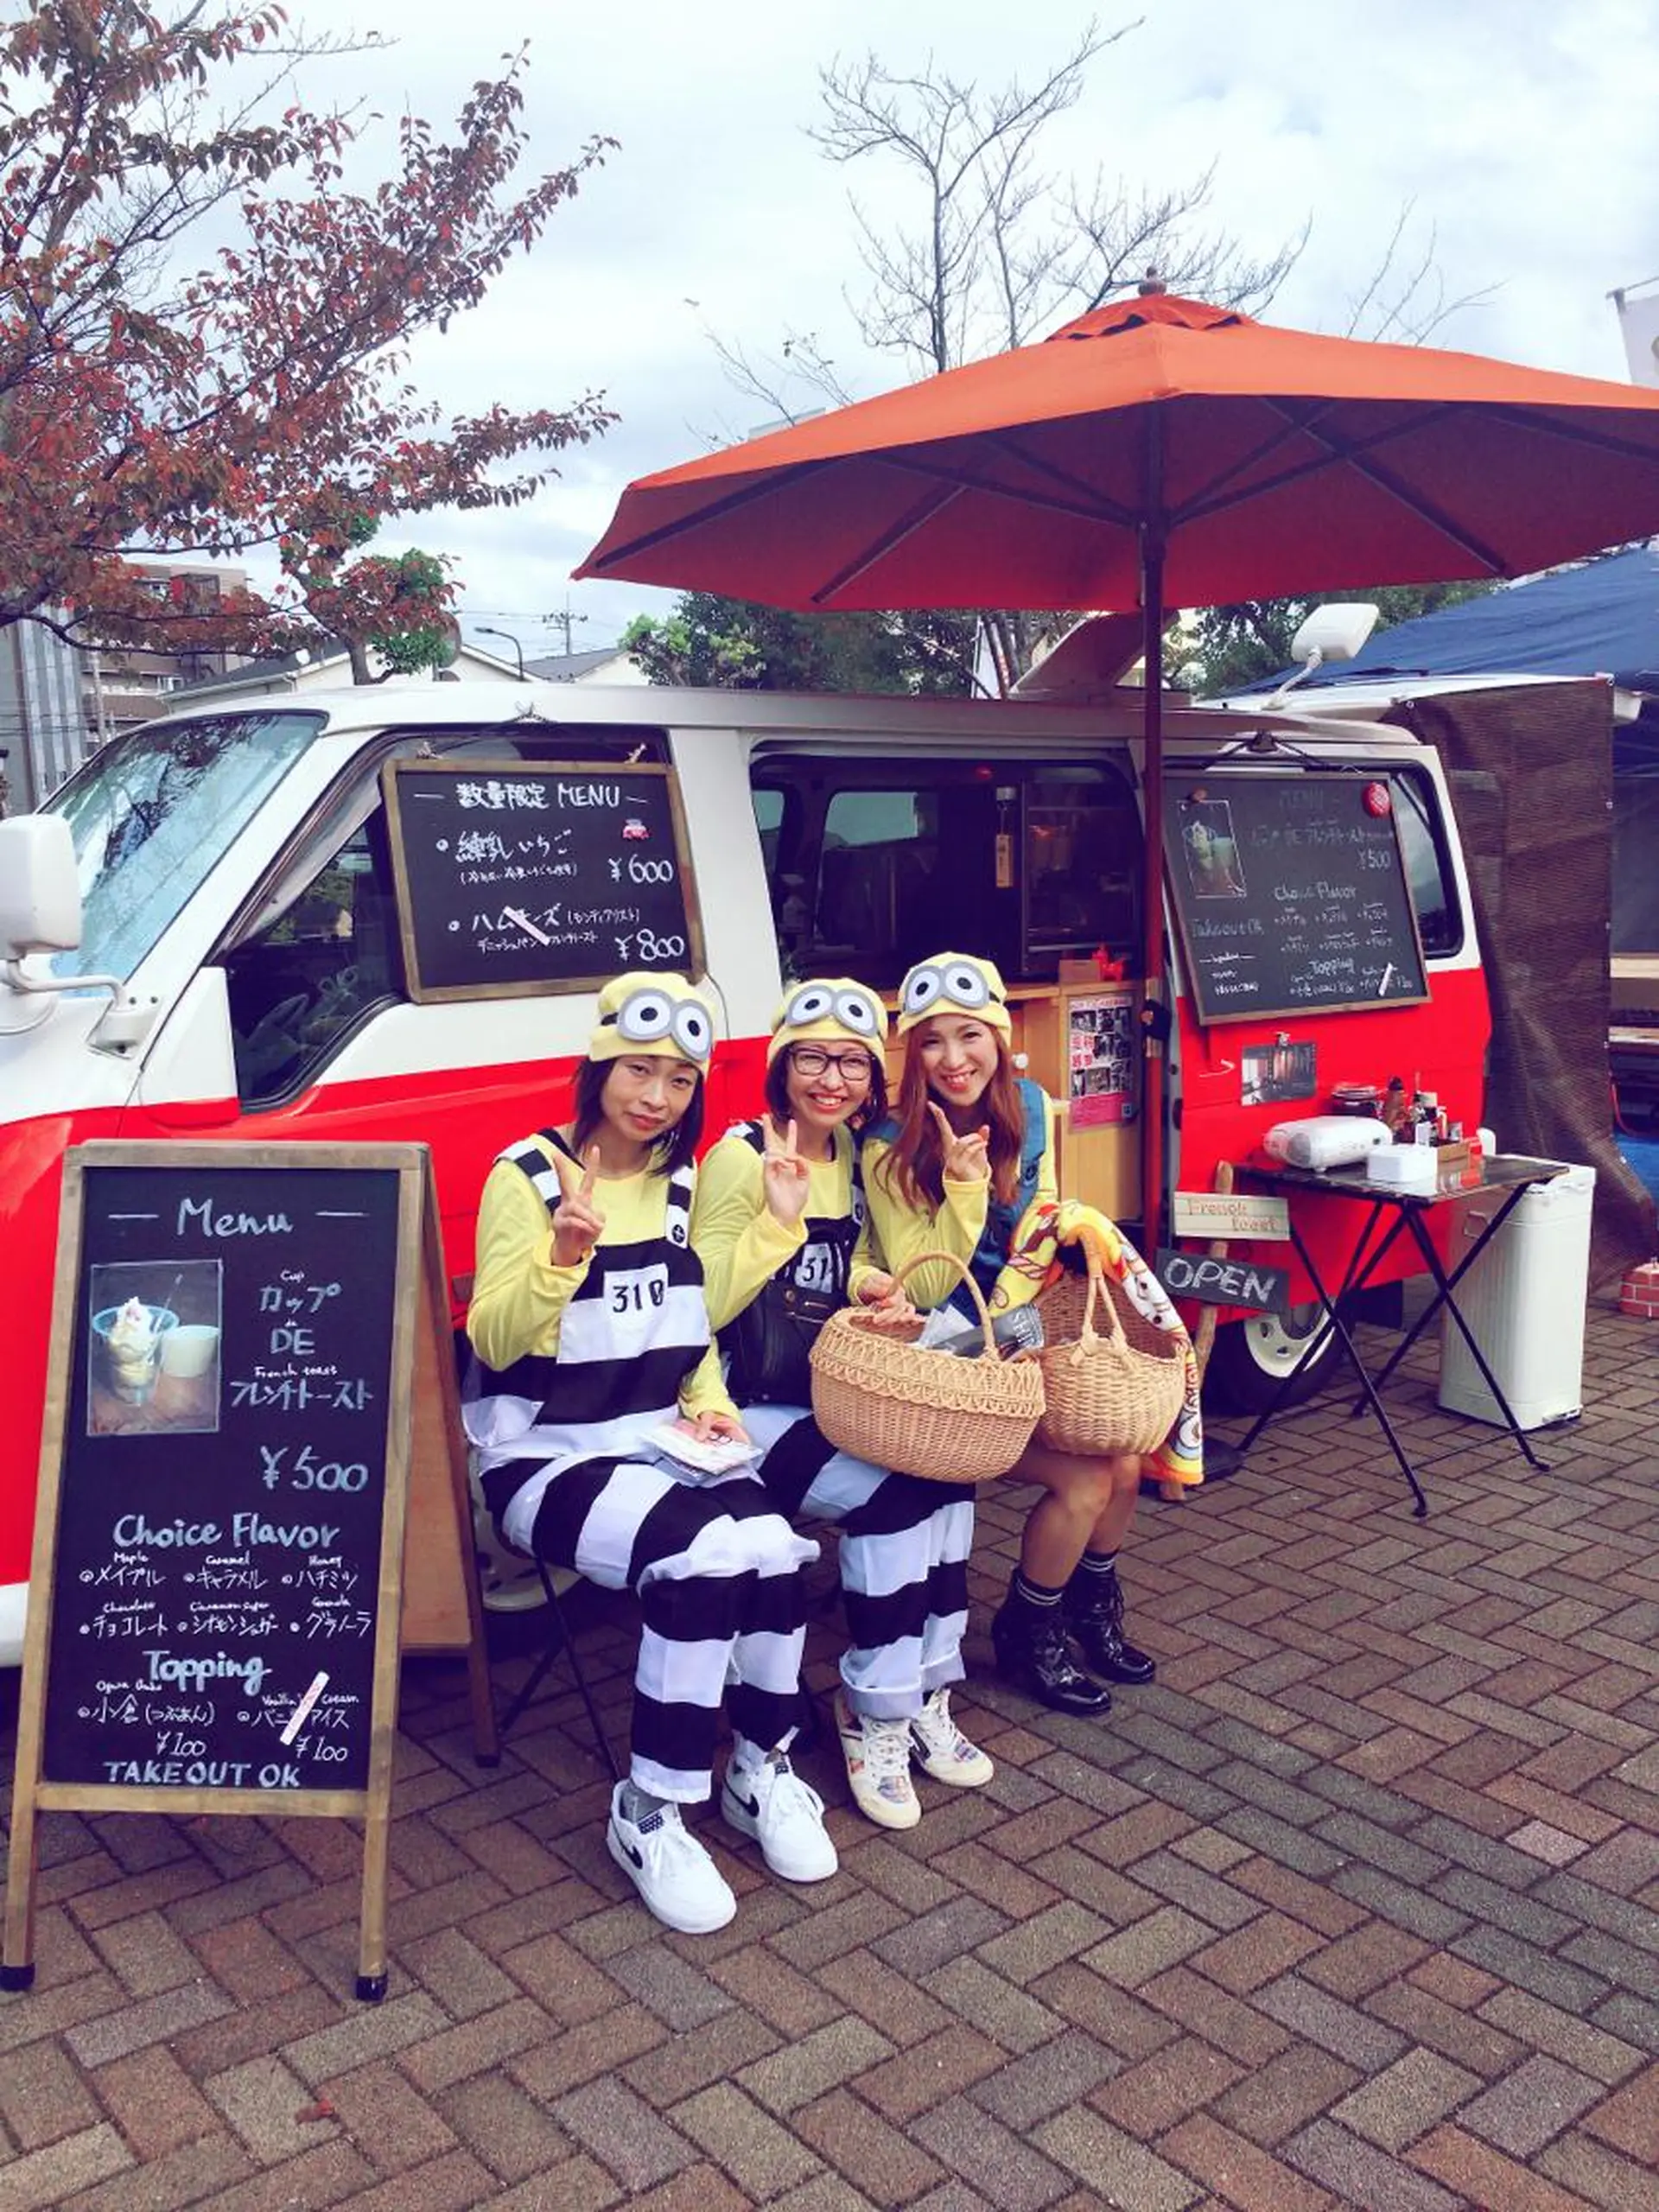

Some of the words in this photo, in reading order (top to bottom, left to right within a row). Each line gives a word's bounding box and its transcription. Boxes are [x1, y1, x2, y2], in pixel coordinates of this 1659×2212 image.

[455, 781, 550, 810] 数量限定
[558, 783, 620, 809] MENU
[607, 854, 674, 883] ¥600
[614, 928, 685, 961] ¥800
[176, 1197, 294, 1237] Menu
[1164, 1258, 1276, 1303] OPEN
[259, 1281, 343, 1313] カップ
[270, 1328, 315, 1356] DE
[229, 1378, 374, 1411] フレンチトースト
[259, 1444, 369, 1492] ¥500
[112, 1514, 224, 1549] Choice
[232, 1512, 341, 1549] Flavor
[94, 1564, 168, 1588] メイプル
[195, 1565, 269, 1590] キャラメル
[295, 1568, 359, 1592] ハチミツ
[92, 1613, 168, 1640] チョコレート
[143, 1649, 272, 1696] Topping
[156, 1731, 208, 1758] ¥100
[296, 1734, 349, 1763] ¥100
[258, 1762, 302, 1789] OK
